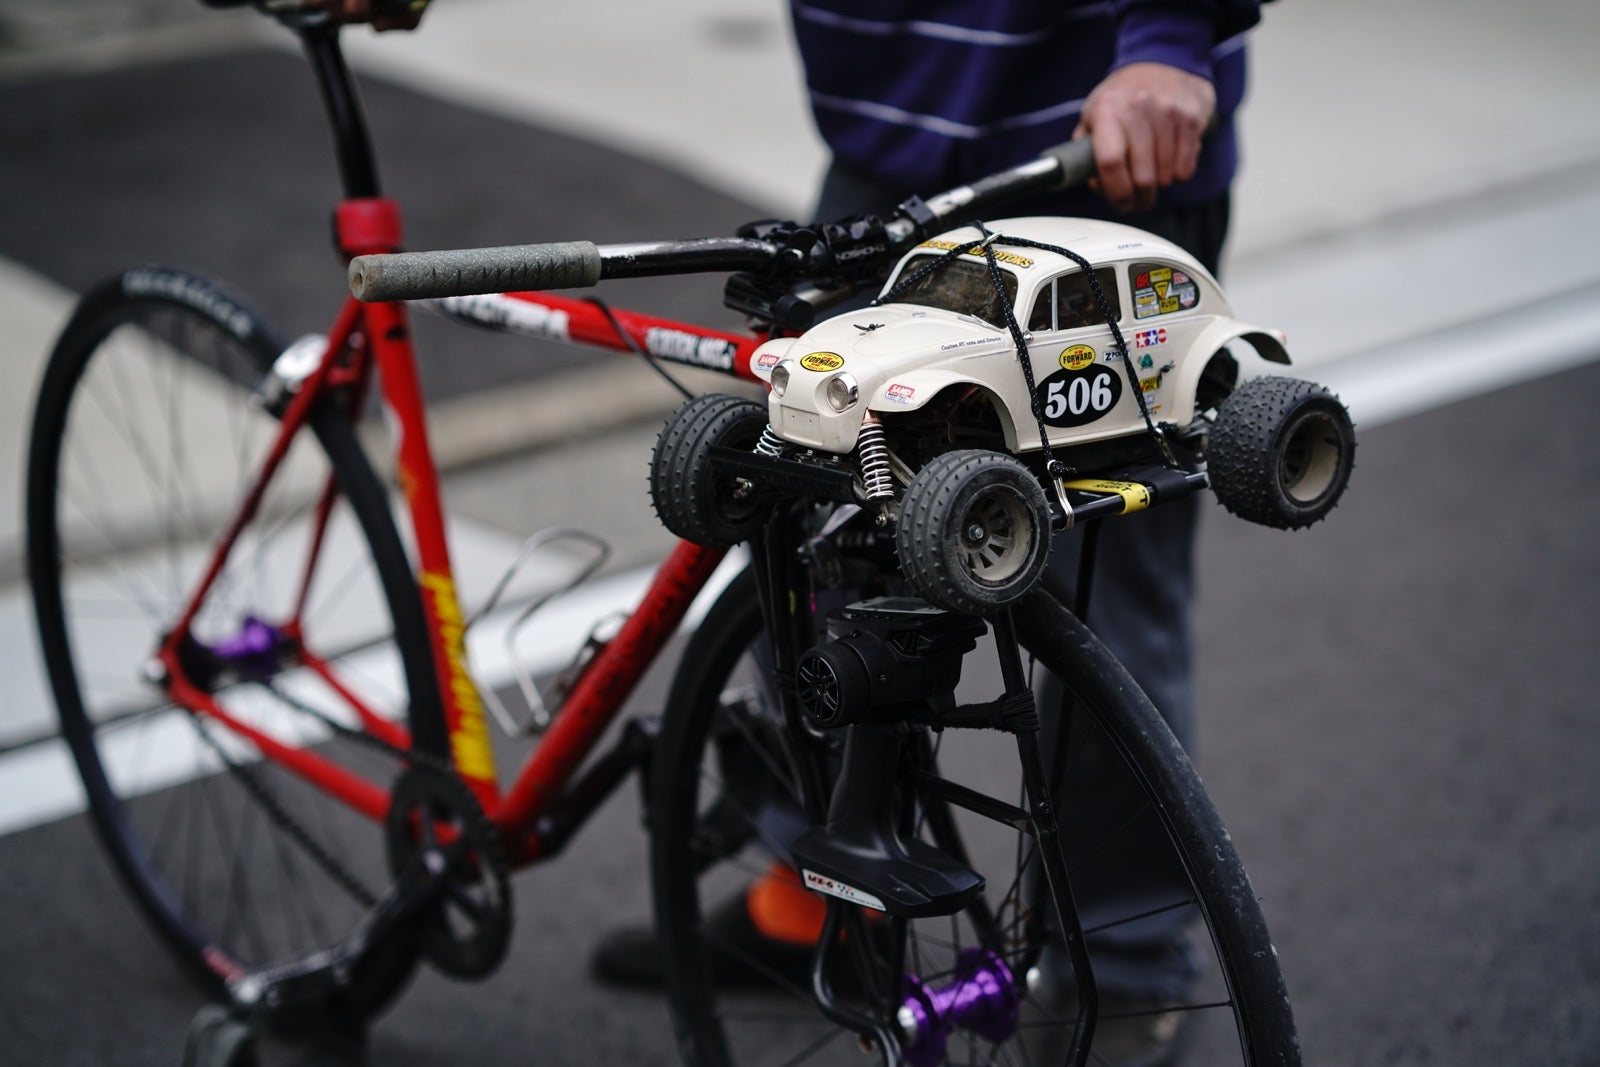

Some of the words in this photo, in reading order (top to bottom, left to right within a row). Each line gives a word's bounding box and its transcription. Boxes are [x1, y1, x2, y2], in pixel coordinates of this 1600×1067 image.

[804, 355, 840, 368] FORWARD
[1063, 351, 1093, 364] FORWARD
[1044, 372, 1113, 419] 506
